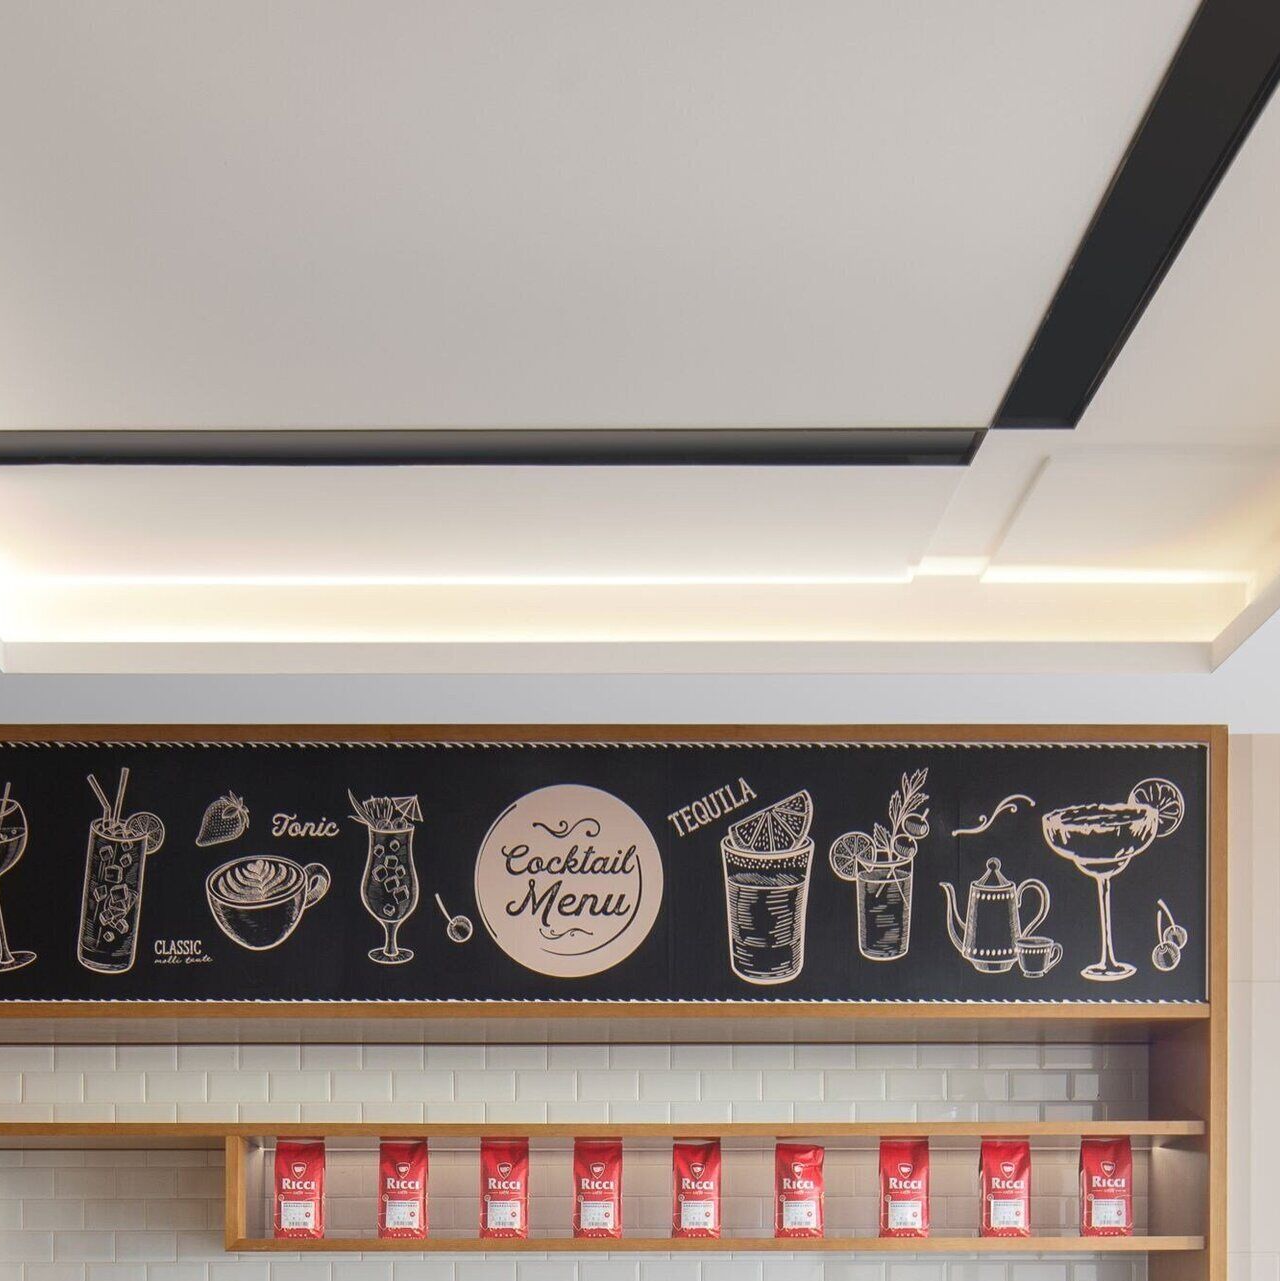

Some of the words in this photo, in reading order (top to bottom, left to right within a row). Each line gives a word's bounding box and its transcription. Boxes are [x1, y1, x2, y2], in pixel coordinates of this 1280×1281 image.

[667, 777, 757, 837] TEQUILA
[272, 813, 340, 837] Tonic
[501, 844, 637, 876] Cocktail
[505, 878, 631, 927] Menu
[154, 939, 202, 955] CLASSIC
